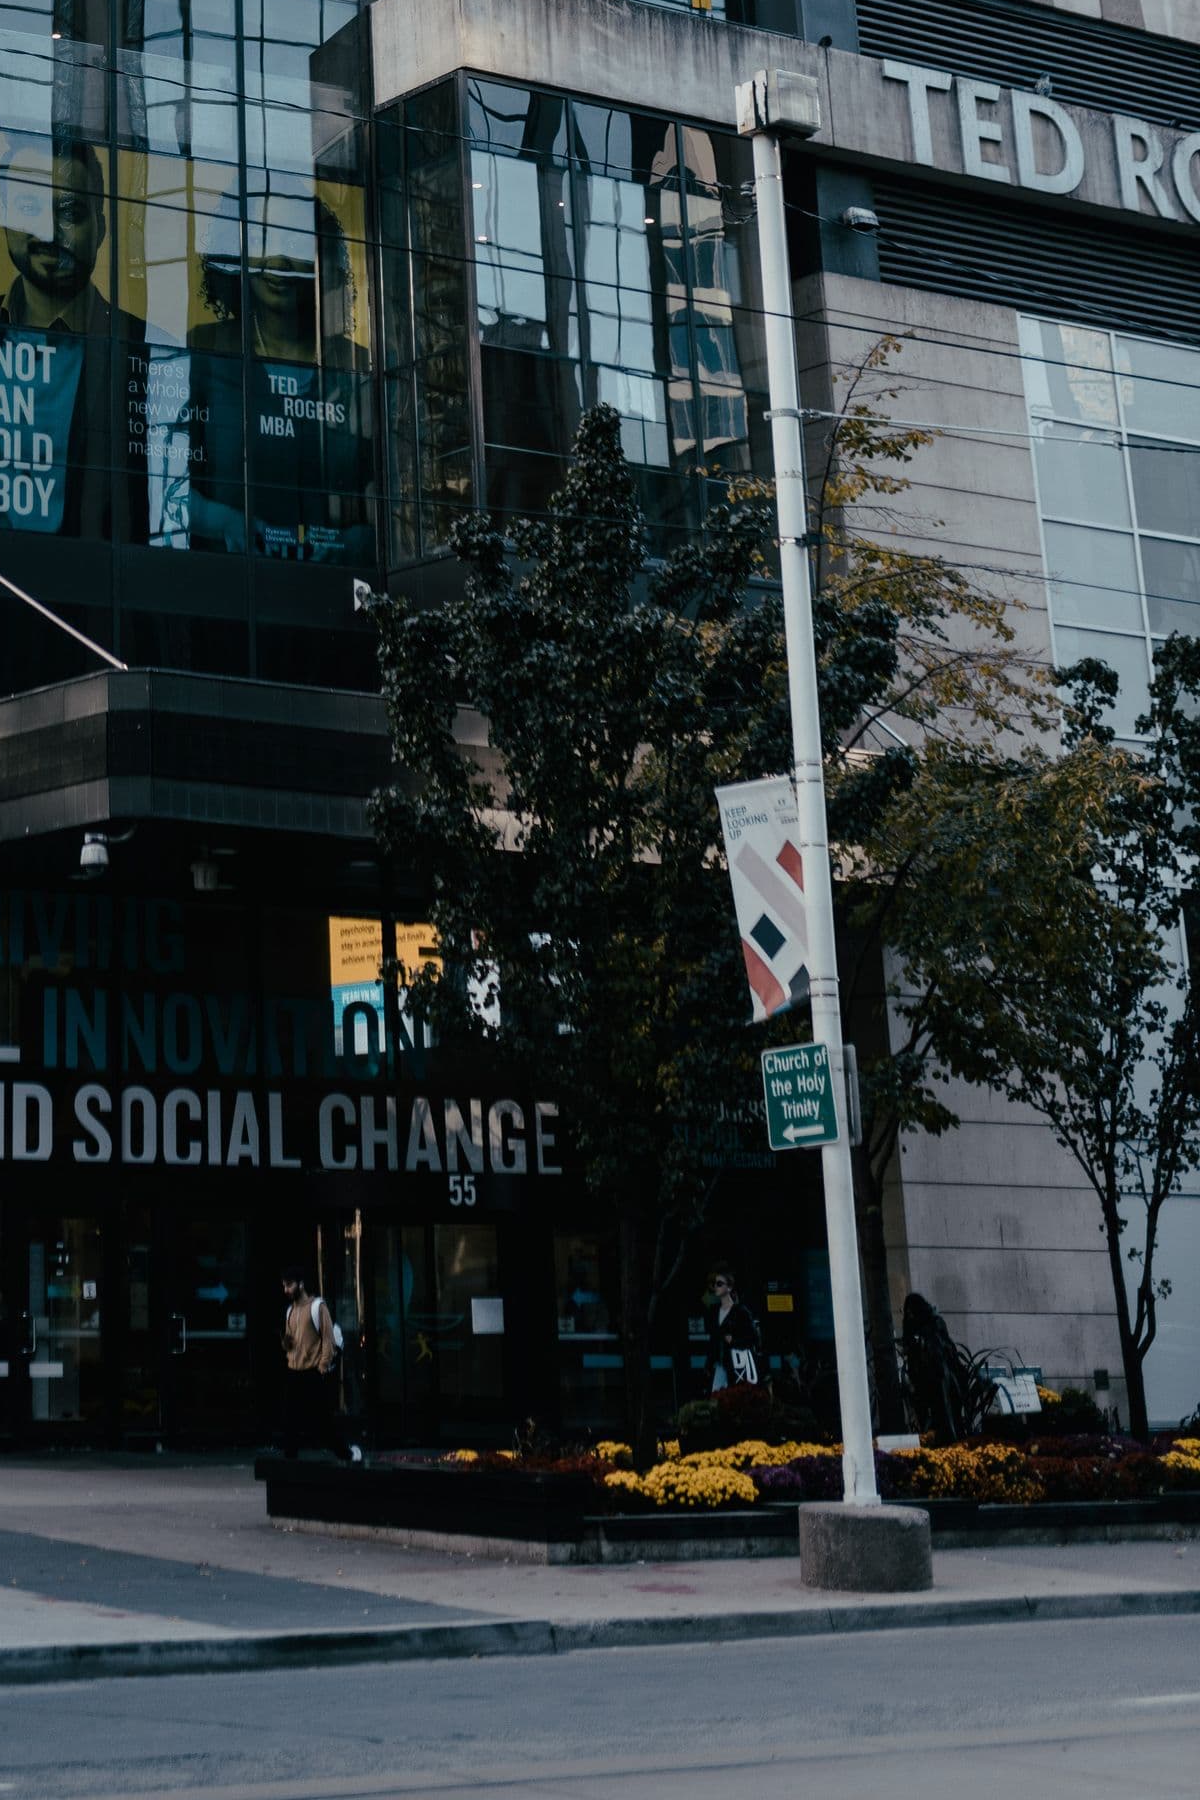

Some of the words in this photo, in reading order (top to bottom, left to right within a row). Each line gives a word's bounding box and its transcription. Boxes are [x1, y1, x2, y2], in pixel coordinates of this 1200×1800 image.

[882, 58, 1085, 195] TED
[128, 355, 184, 379] There's
[128, 380, 138, 393] a
[142, 380, 189, 399] whole
[268, 374, 298, 396] TED
[128, 400, 161, 416] new
[167, 404, 210, 423] world
[284, 397, 345, 423] ROGERS
[128, 417, 144, 434] to
[149, 419, 168, 436] be
[260, 414, 296, 438] MBA
[128, 440, 208, 462] mastered.
[724, 806, 747, 818] KEEP
[727, 813, 768, 830] LOOKING
[729, 829, 742, 840] UP
[42, 983, 427, 1080] INNOVATION
[765, 1050, 809, 1074] Church
[814, 1046, 827, 1067] of
[771, 1077, 792, 1097] the
[796, 1072, 825, 1096] Holy
[781, 1098, 820, 1121] Trinity
[73, 1083, 301, 1167] SOCIAL
[318, 1094, 563, 1174] CHANGE
[449, 1175, 476, 1206] 55
